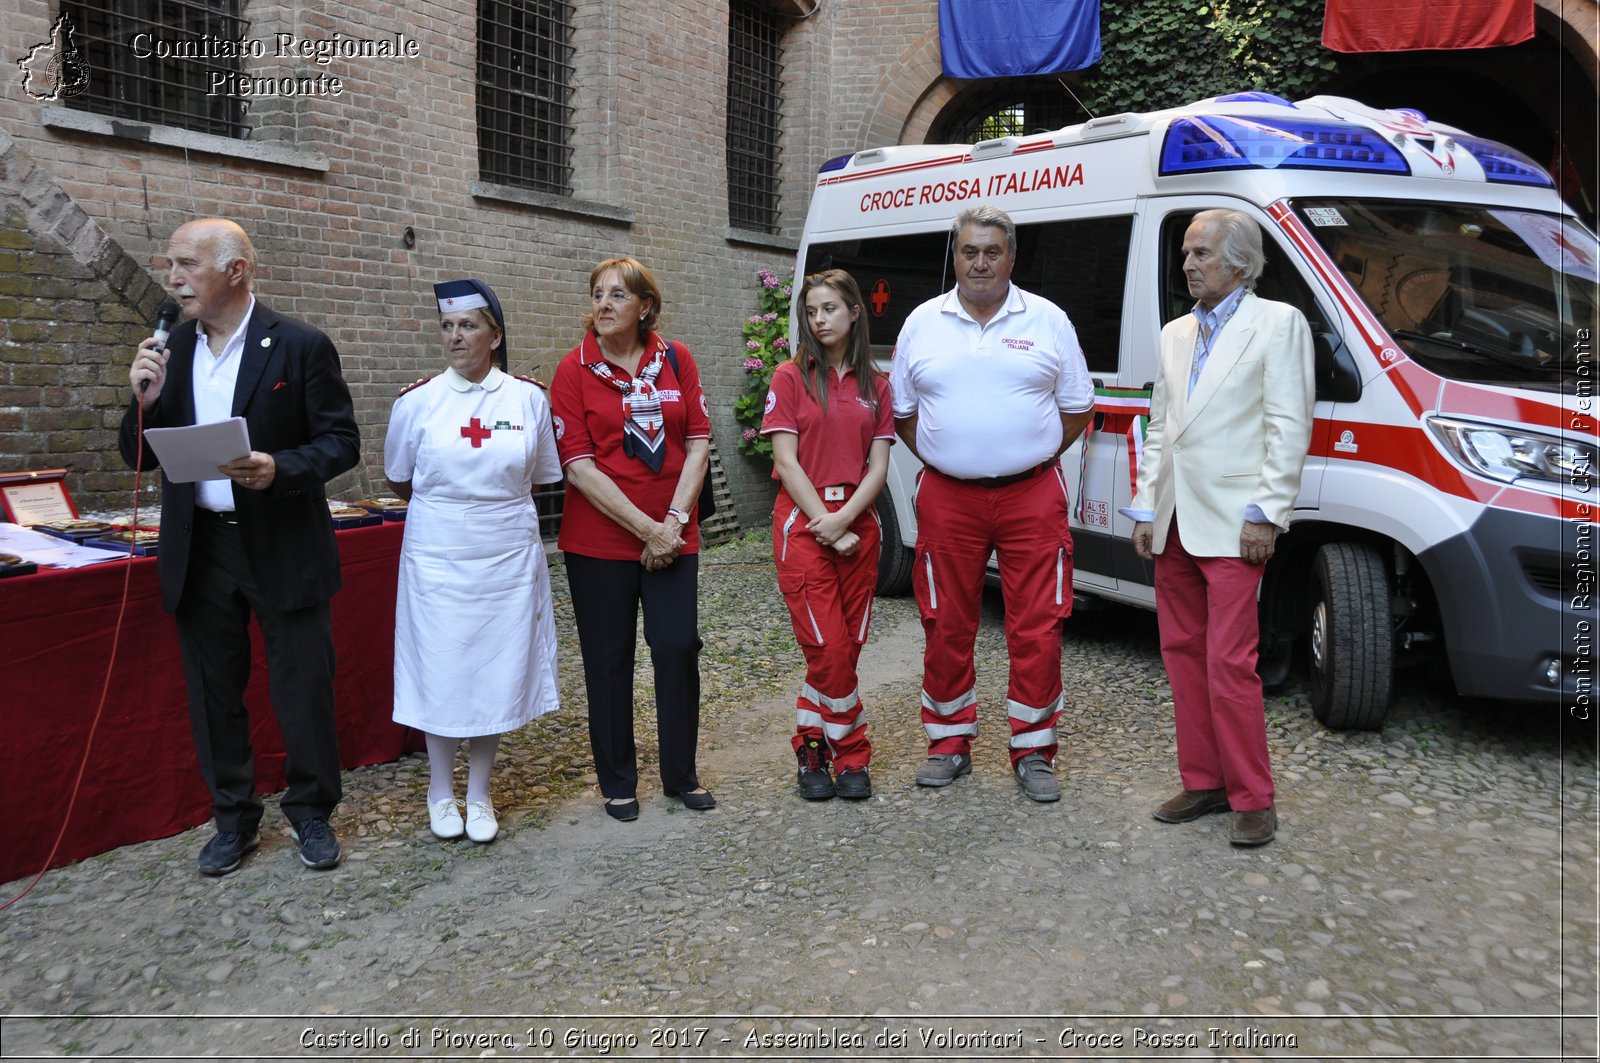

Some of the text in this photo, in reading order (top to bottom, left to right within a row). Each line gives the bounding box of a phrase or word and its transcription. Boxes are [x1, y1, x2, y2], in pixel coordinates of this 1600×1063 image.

[860, 162, 1085, 212] CROCE ROSSA ITALIANA
[1323, 208, 1336, 216] 15
[1087, 502, 1105, 513] AL 15
